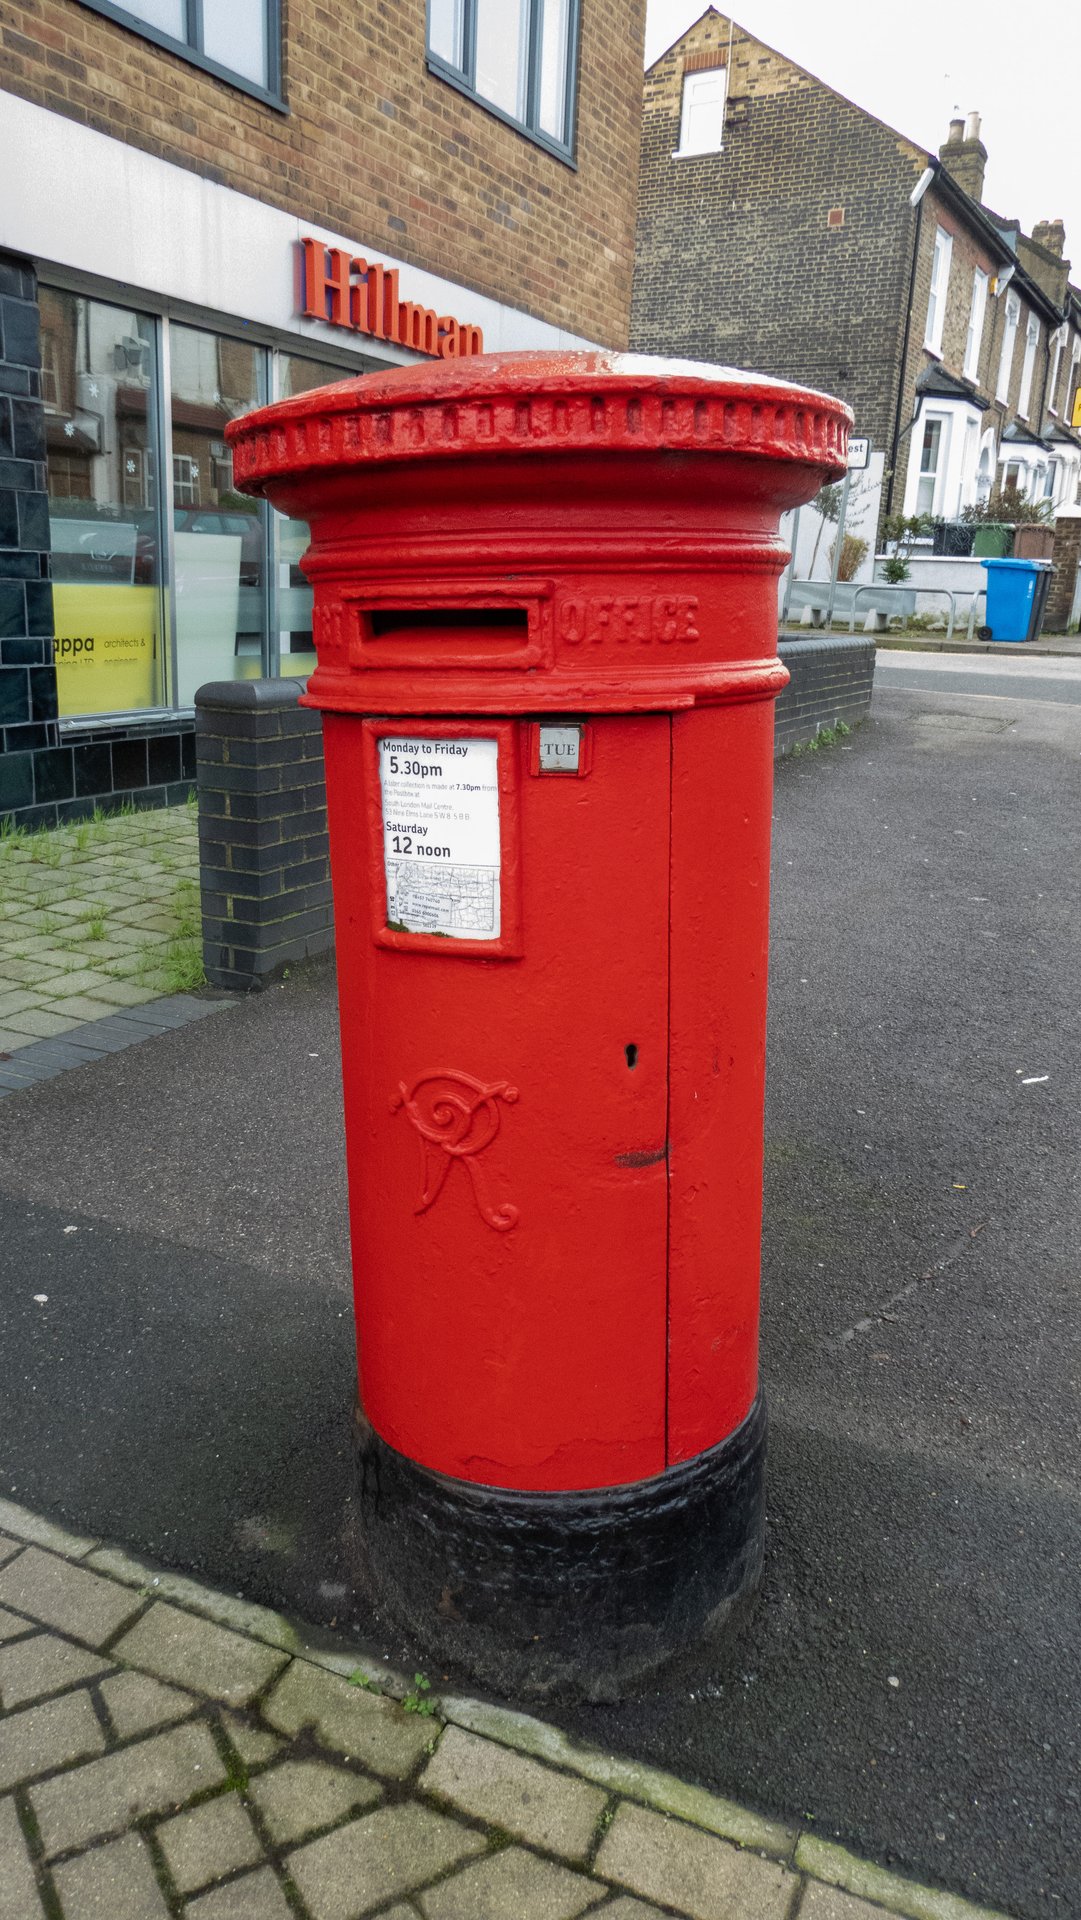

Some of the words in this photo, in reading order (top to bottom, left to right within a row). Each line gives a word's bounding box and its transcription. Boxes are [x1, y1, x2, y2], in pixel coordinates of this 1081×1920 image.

[561, 595, 700, 645] OFFICE
[104, 638, 139, 649] architects
[383, 741, 419, 755] Monday
[422, 743, 432, 754] to
[435, 743, 468, 757] Friday
[544, 743, 576, 756] TUE
[390, 755, 443, 779] 5.30pm
[400, 781, 425, 789] collection
[456, 783, 481, 792] 7.30pm
[482, 784, 497, 792] from
[400, 801, 421, 809] London
[386, 821, 428, 837] Saturday
[392, 835, 413, 854] 12
[417, 844, 451, 858] noon
